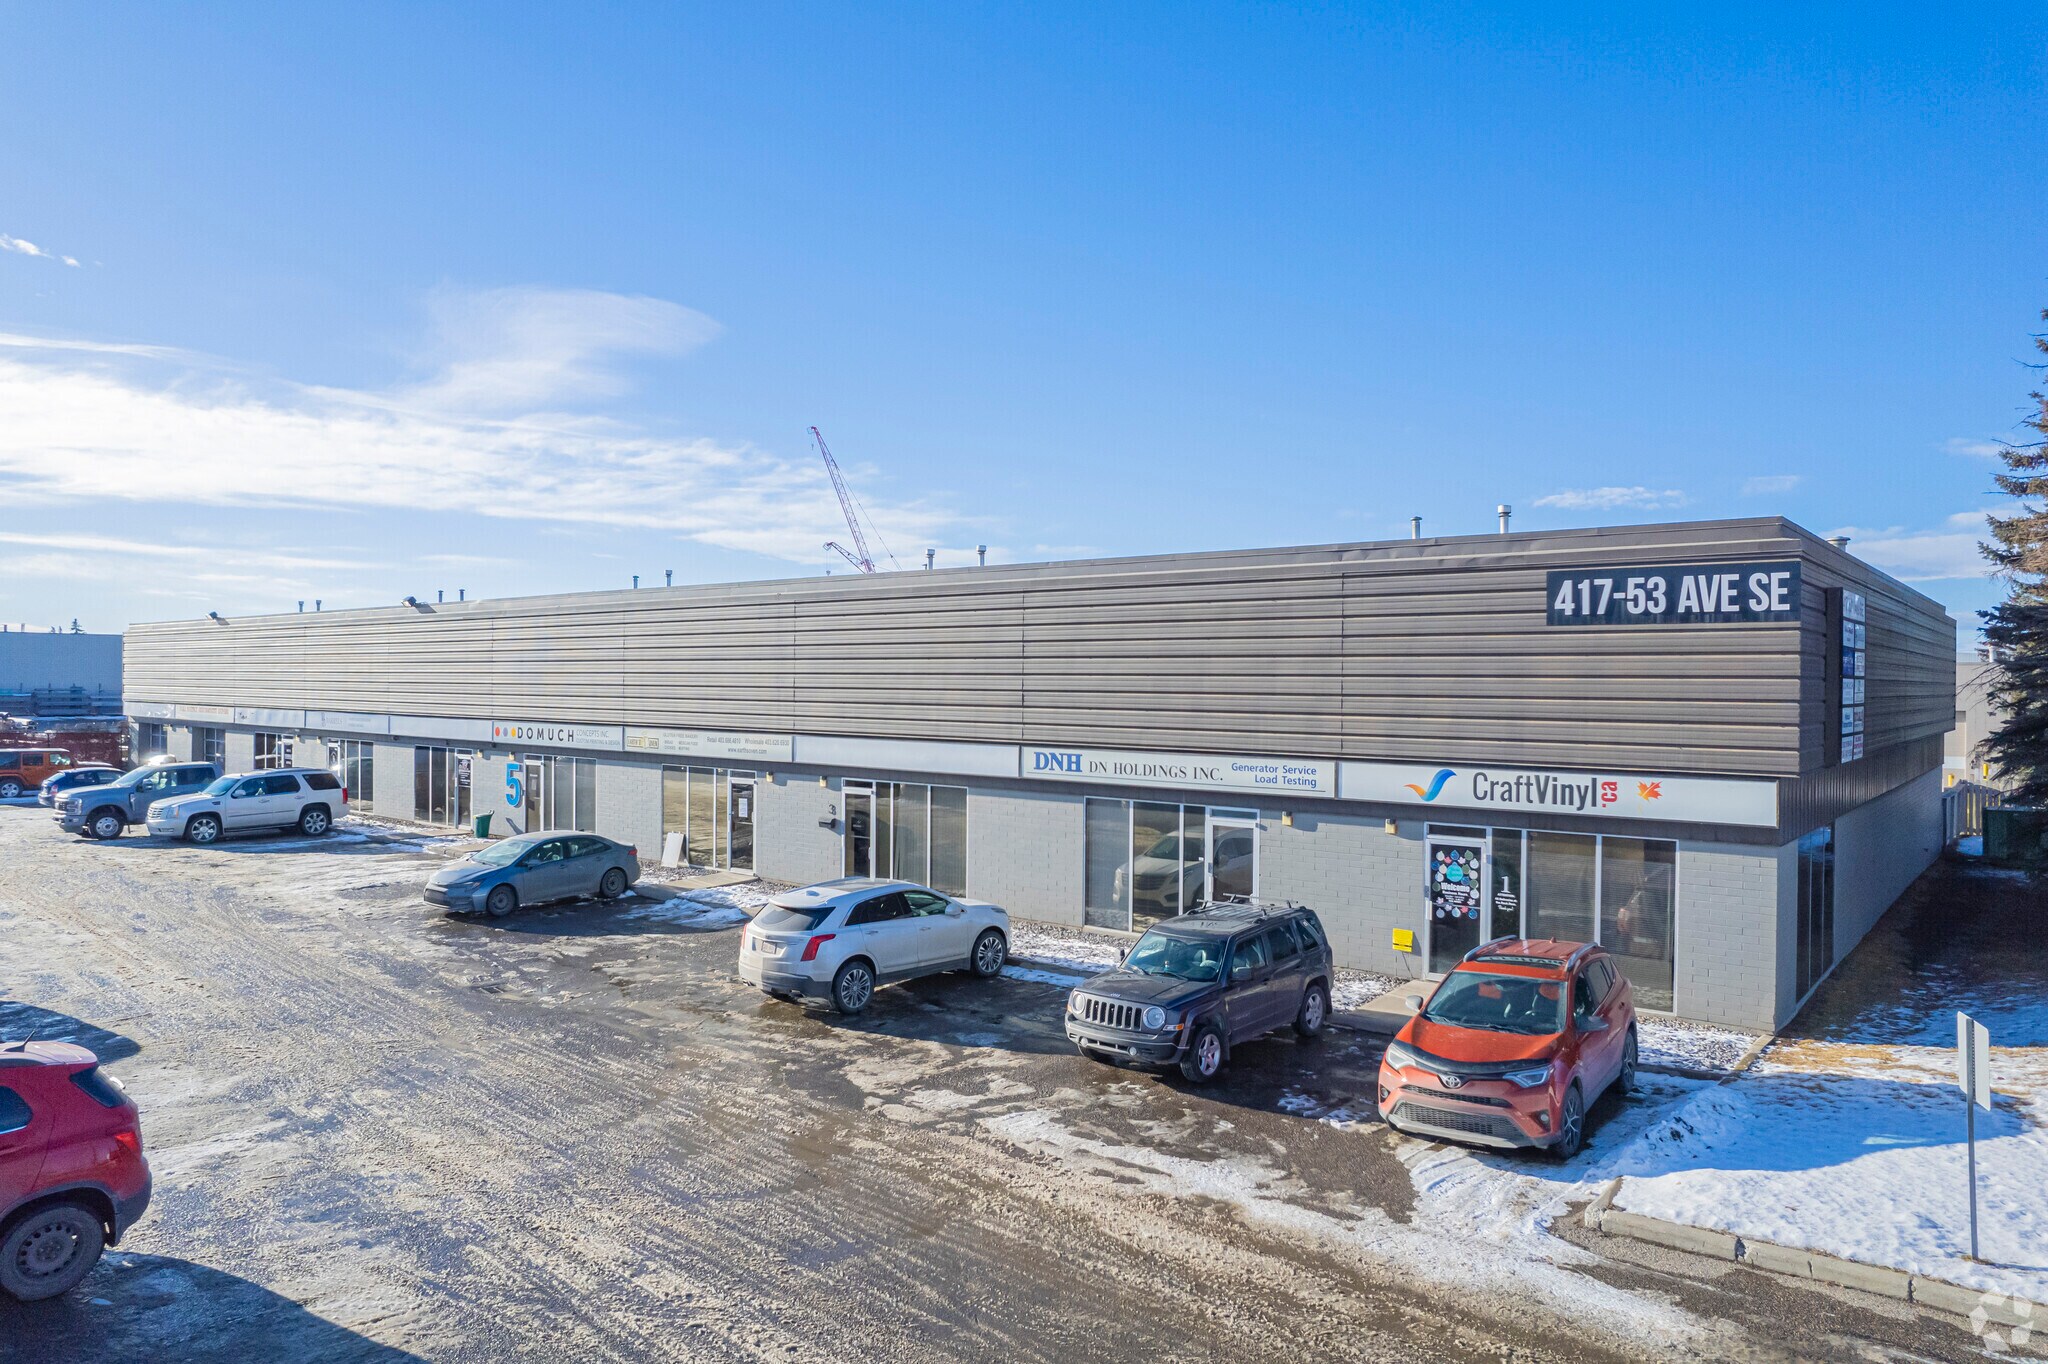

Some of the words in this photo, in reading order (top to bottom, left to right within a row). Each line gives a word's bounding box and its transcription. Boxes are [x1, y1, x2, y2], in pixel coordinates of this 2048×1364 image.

[1554, 576, 1667, 616] 417-53
[1677, 573, 1740, 613] AVE
[1748, 571, 1791, 612] SE
[517, 727, 574, 742] DOMUCH
[576, 728, 600, 738] CONCEPTS
[1033, 751, 1083, 773] DNH
[1089, 760, 1108, 774] DN
[1113, 762, 1187, 779] HOLDINGS
[1193, 766, 1223, 781] INC.
[1231, 762, 1279, 774] Generator
[1282, 764, 1317, 776] Service
[505, 762, 521, 807] 5
[1254, 774, 1278, 785] Load
[1282, 775, 1317, 789] Testing
[1472, 771, 1598, 811] CraftVinyl
[828, 804, 836, 815] 3
[1441, 882, 1470, 893] Welcome
[1501, 876, 1511, 893] 1
